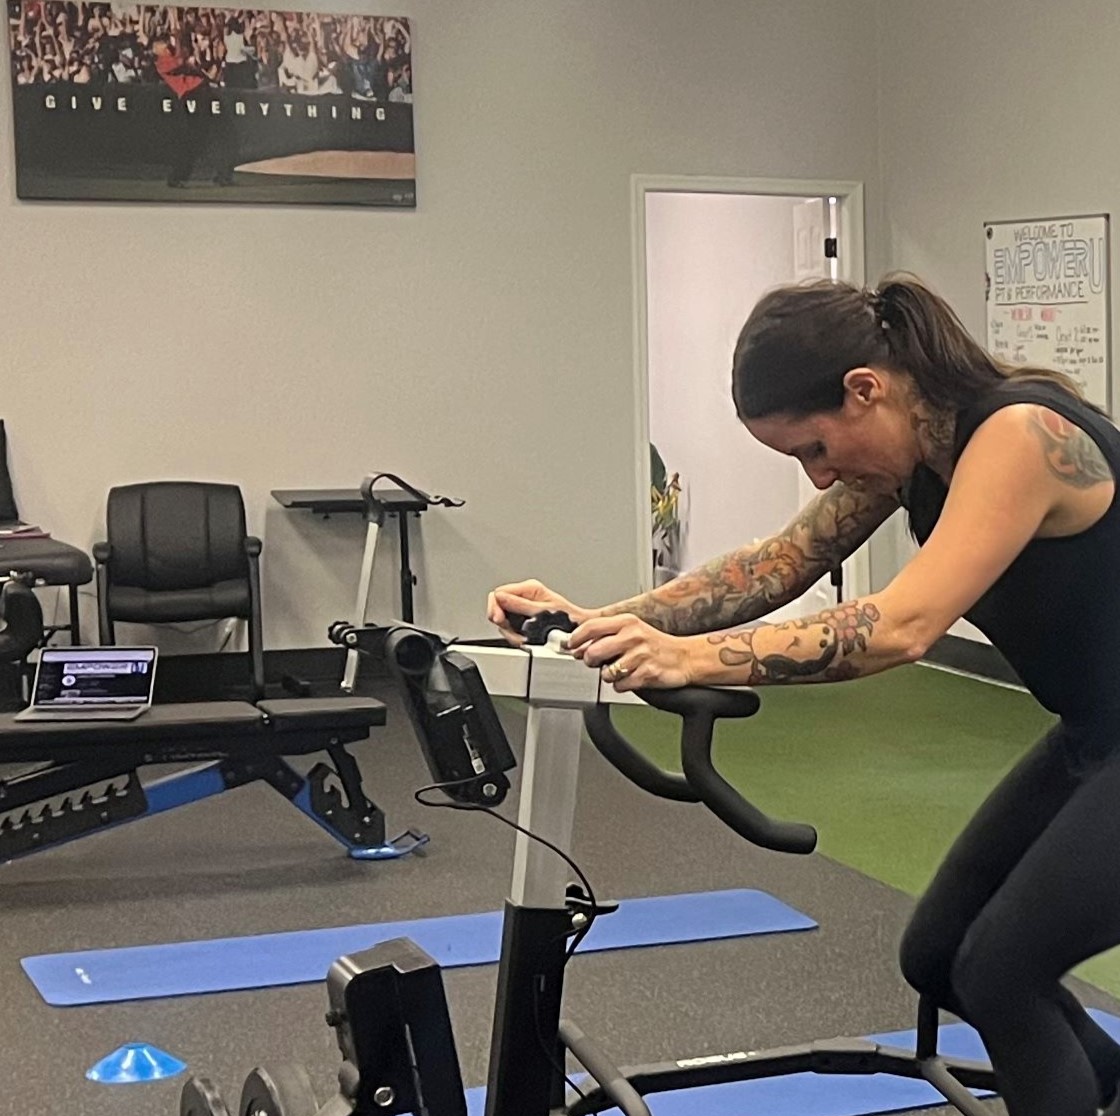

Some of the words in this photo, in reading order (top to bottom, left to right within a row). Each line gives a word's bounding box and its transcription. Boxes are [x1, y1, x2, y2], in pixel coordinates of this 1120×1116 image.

[45, 95, 127, 112] GIVE
[162, 98, 386, 121] EVERYTHING
[1014, 224, 1058, 241] WELCOME
[1060, 222, 1074, 238] TO
[1015, 281, 1084, 301] PERFORMANCE
